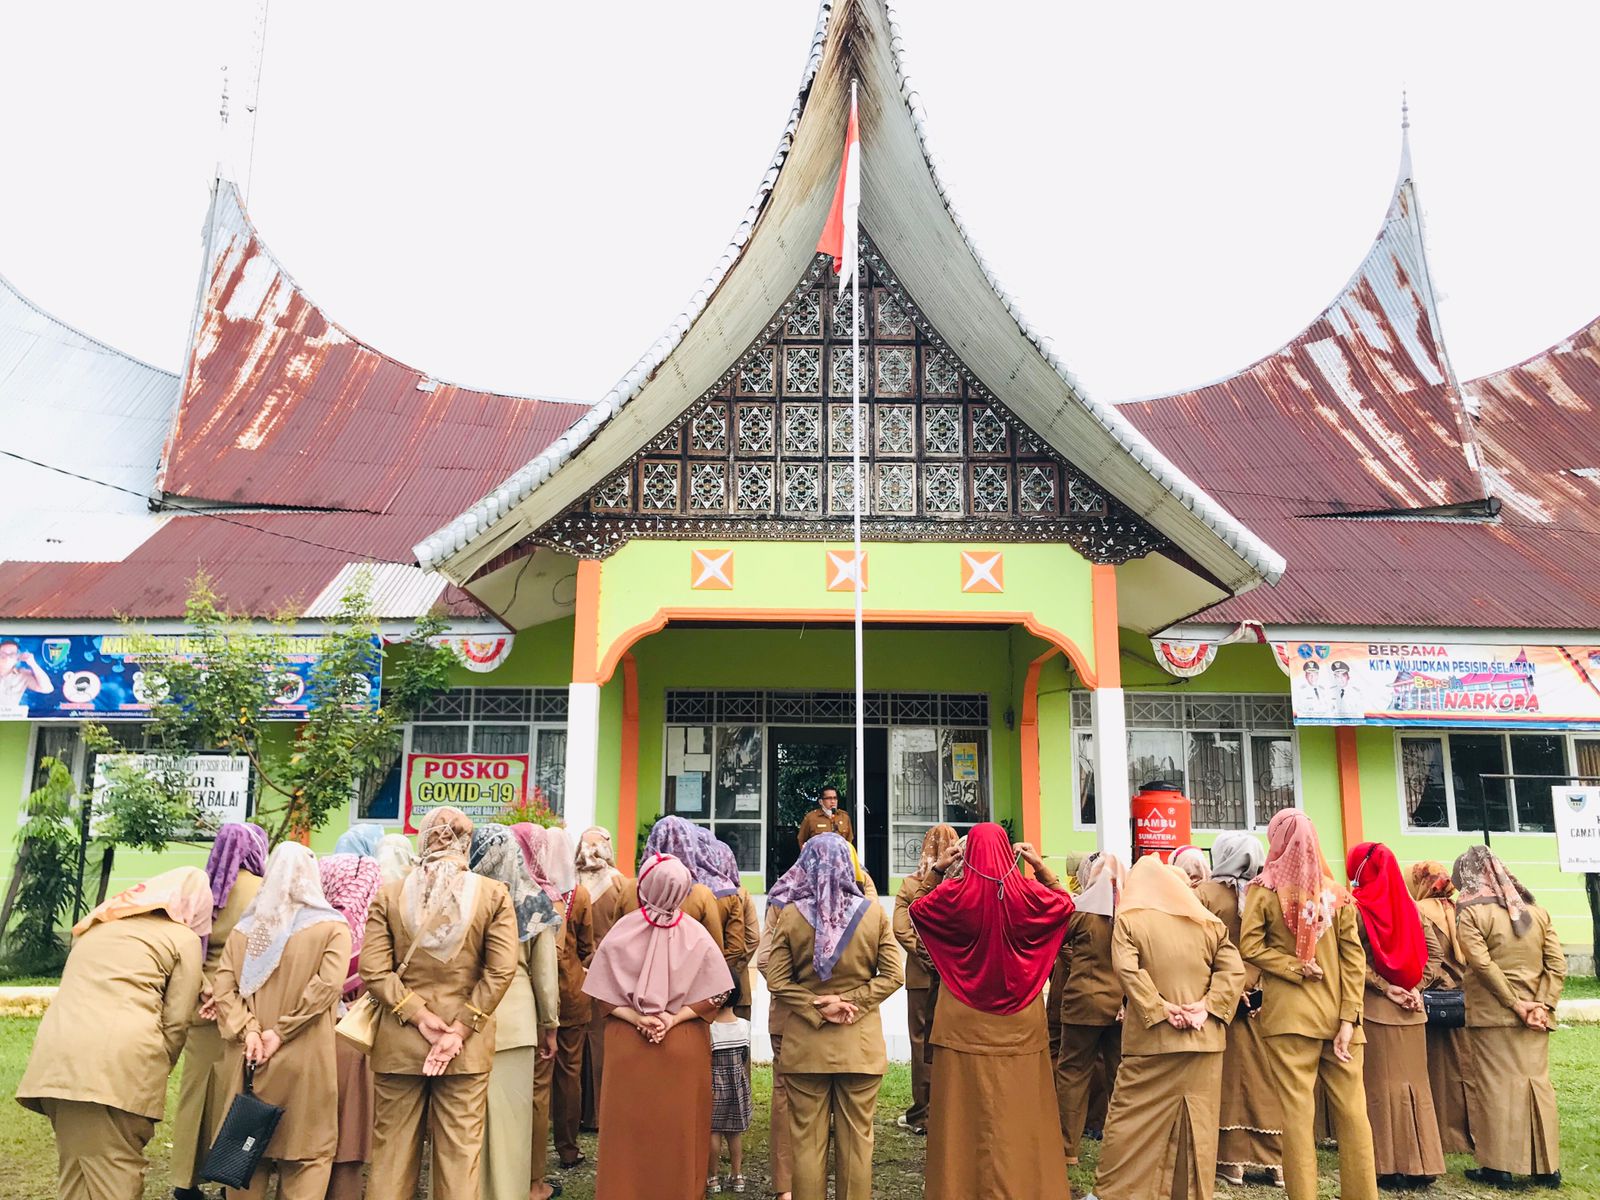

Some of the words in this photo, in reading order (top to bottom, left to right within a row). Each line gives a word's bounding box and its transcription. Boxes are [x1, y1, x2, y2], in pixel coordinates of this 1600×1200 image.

[1368, 645, 1449, 657] BERSAMA
[1369, 659, 1392, 671] KITA
[1394, 660, 1450, 672] WUJUDKAN
[1453, 661, 1488, 673] PESISIR
[1490, 662, 1536, 674] SELATAN
[1413, 675, 1464, 690] Bersih
[424, 761, 509, 779] POSKO
[418, 782, 514, 803] COVID-19
[1137, 818, 1177, 828] BAMBU
[1138, 833, 1177, 841] SUMATERA
[1570, 828, 1595, 838] CAMAT
